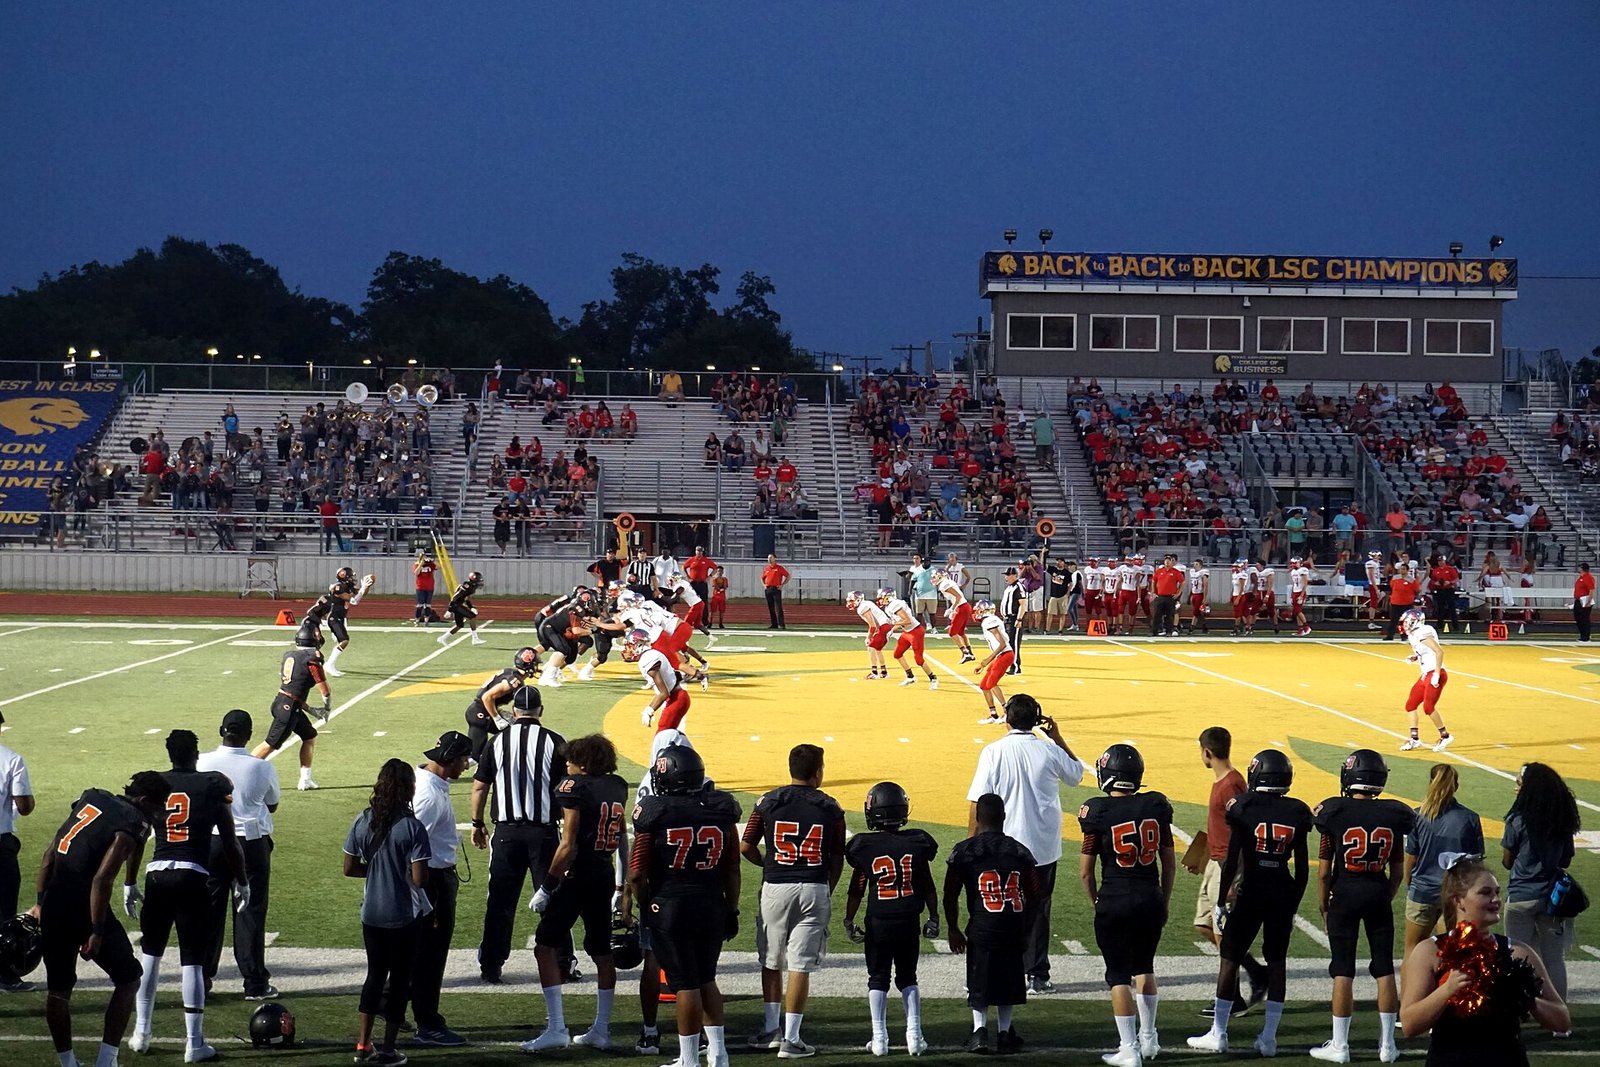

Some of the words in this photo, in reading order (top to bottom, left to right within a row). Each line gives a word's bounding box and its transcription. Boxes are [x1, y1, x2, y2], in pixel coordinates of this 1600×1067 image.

[1023, 255, 1092, 276] BACK
[1092, 260, 1105, 272] to
[1107, 255, 1177, 277] BACK
[1178, 262, 1191, 273] to
[1192, 256, 1263, 278] BACK
[1268, 258, 1319, 280] LSC
[1325, 258, 1484, 284] CHAMPIONS
[1233, 366, 1285, 374] BUSINESS
[0, 381, 31, 391] EST
[35, 381, 55, 391] IN
[59, 381, 117, 393] CLASS
[0, 443, 47, 454] ON
[0, 460, 65, 472] BALL
[633, 530, 641, 546] 1
[1092, 621, 1106, 633] 40
[1491, 626, 1506, 639] 50
[559, 779, 576, 793] 12
[57, 803, 103, 855] 7
[165, 792, 191, 843] 2
[594, 801, 625, 851] 12
[666, 825, 724, 870] 73
[773, 820, 825, 867] 54
[1110, 818, 1161, 868] 58
[1253, 822, 1296, 854] 17
[1342, 826, 1394, 873] 23
[871, 853, 915, 900] 21
